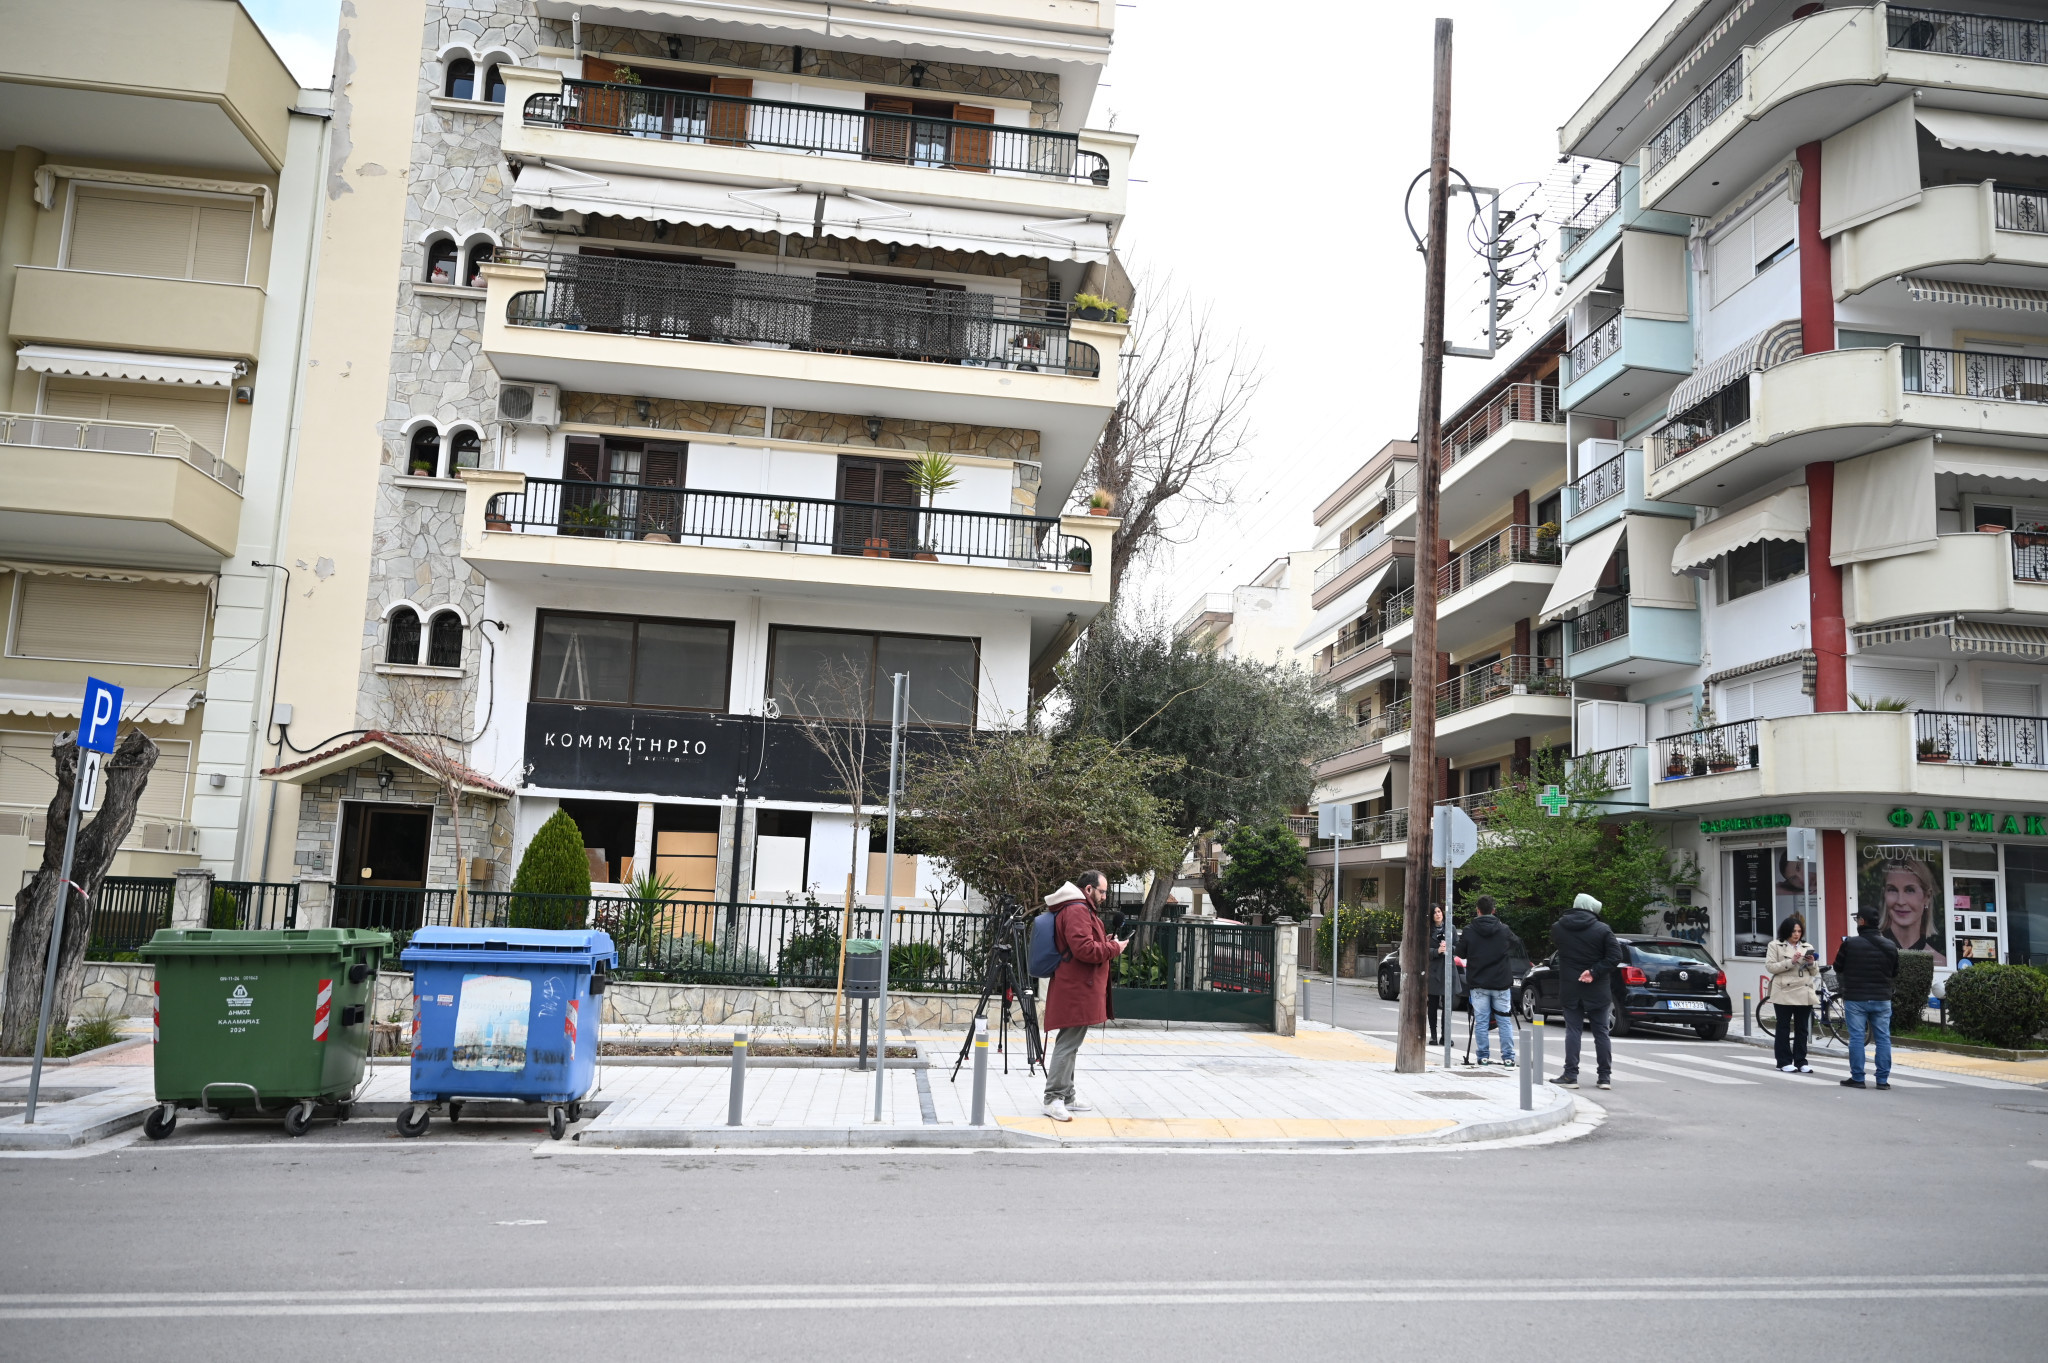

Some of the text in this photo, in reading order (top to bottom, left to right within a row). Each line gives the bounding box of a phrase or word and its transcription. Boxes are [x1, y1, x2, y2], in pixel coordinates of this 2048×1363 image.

[88, 688, 113, 744] P
[545, 732, 707, 755] ΚΟΜΜΩΤΗΡΙΟ
[1700, 813, 1792, 834] ΦΑΡΜΑΚΕΙΟ
[1887, 807, 2047, 836] ΦΑΡΜΑΚ
[1863, 845, 1935, 862] CAUDALIE
